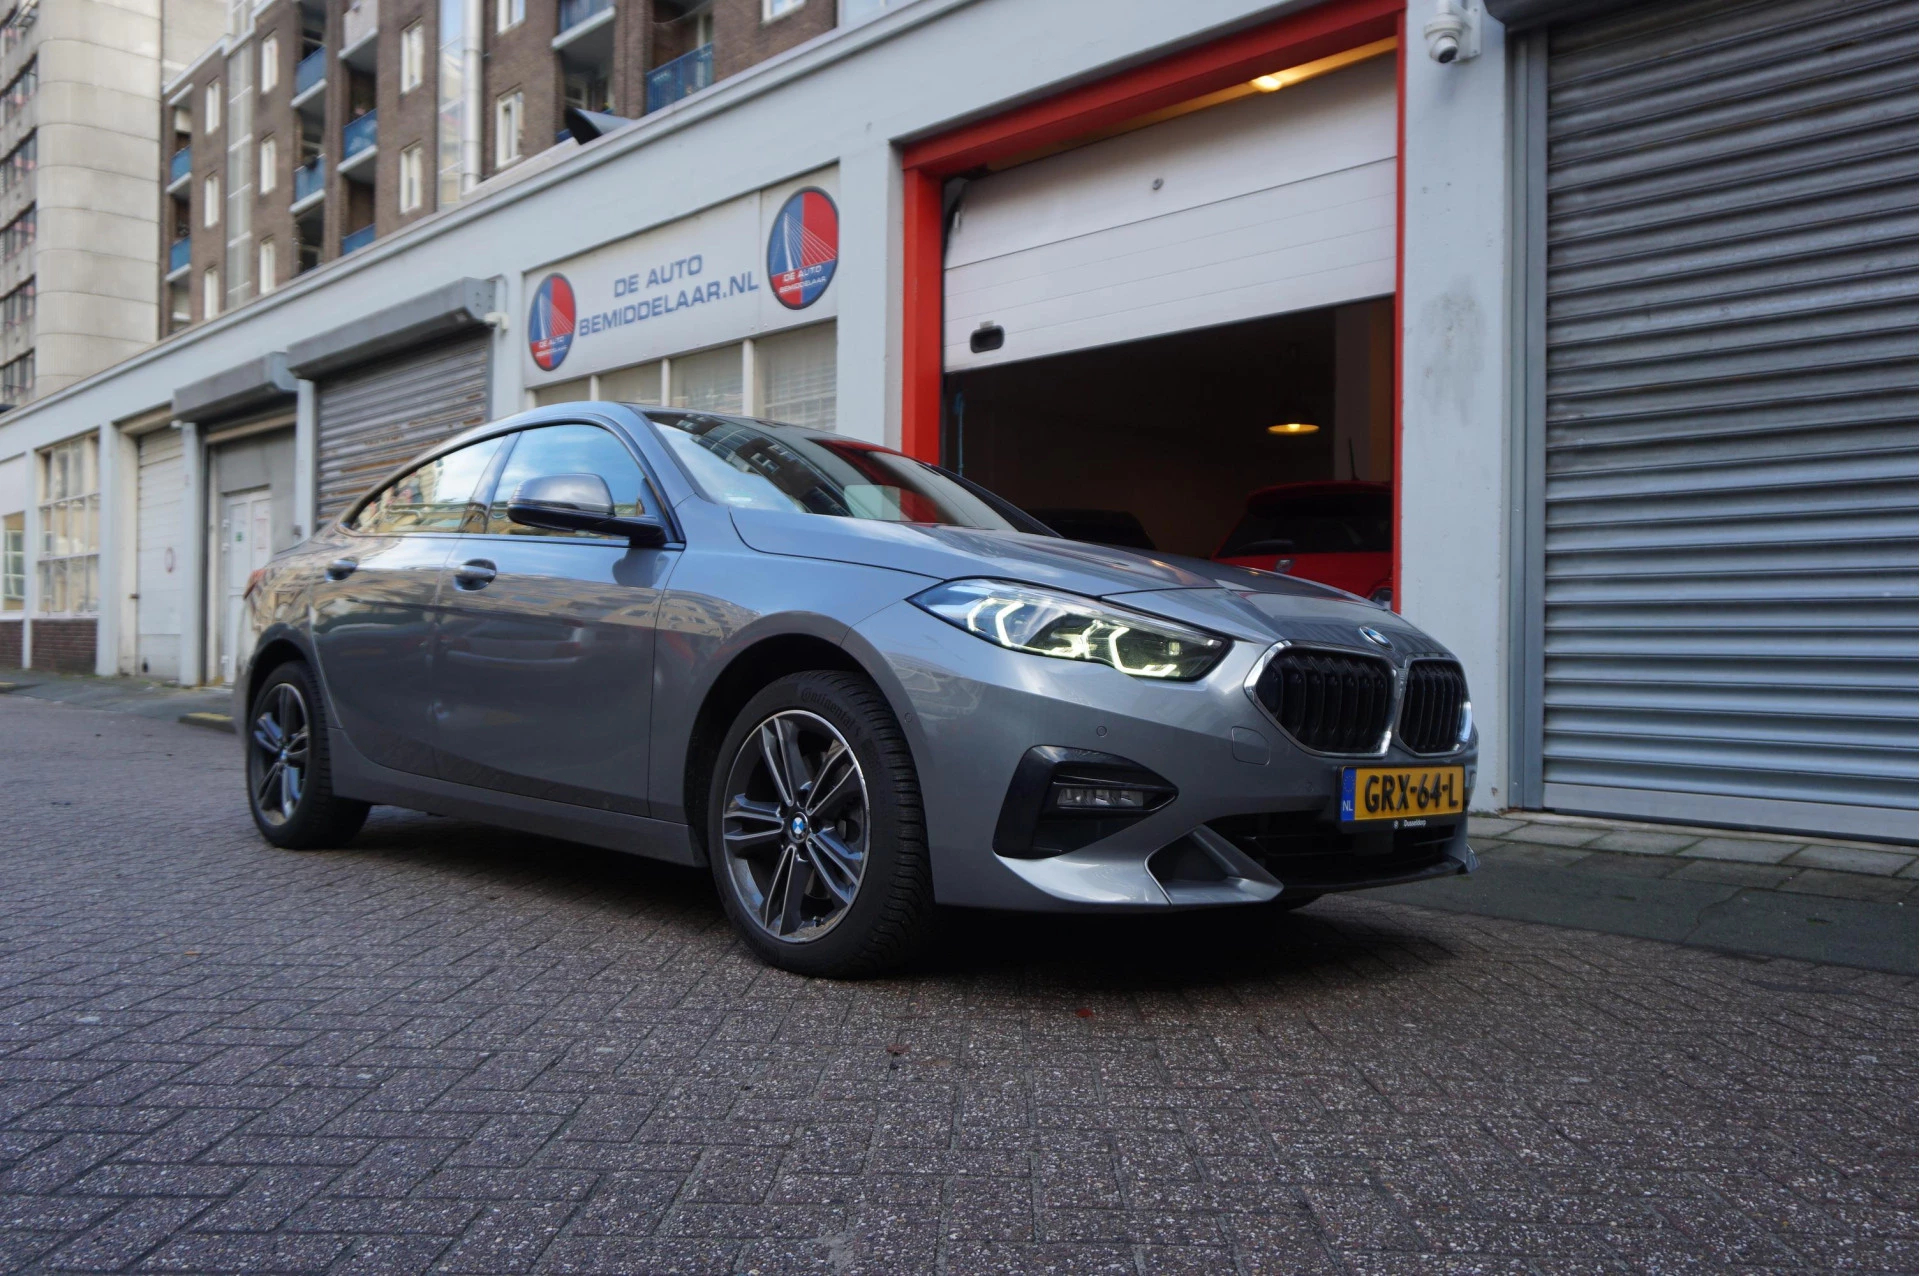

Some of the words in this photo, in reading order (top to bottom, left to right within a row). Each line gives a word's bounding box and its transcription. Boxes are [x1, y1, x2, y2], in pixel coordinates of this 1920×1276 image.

[614, 273, 639, 297] DE
[646, 254, 703, 287] AUTO
[783, 272, 796, 282] DE
[797, 265, 822, 278] AUTO
[578, 271, 759, 337] BEMIDDELAAR.NL
[1342, 800, 1354, 811] NL
[1364, 773, 1459, 813] GRX-64-L
